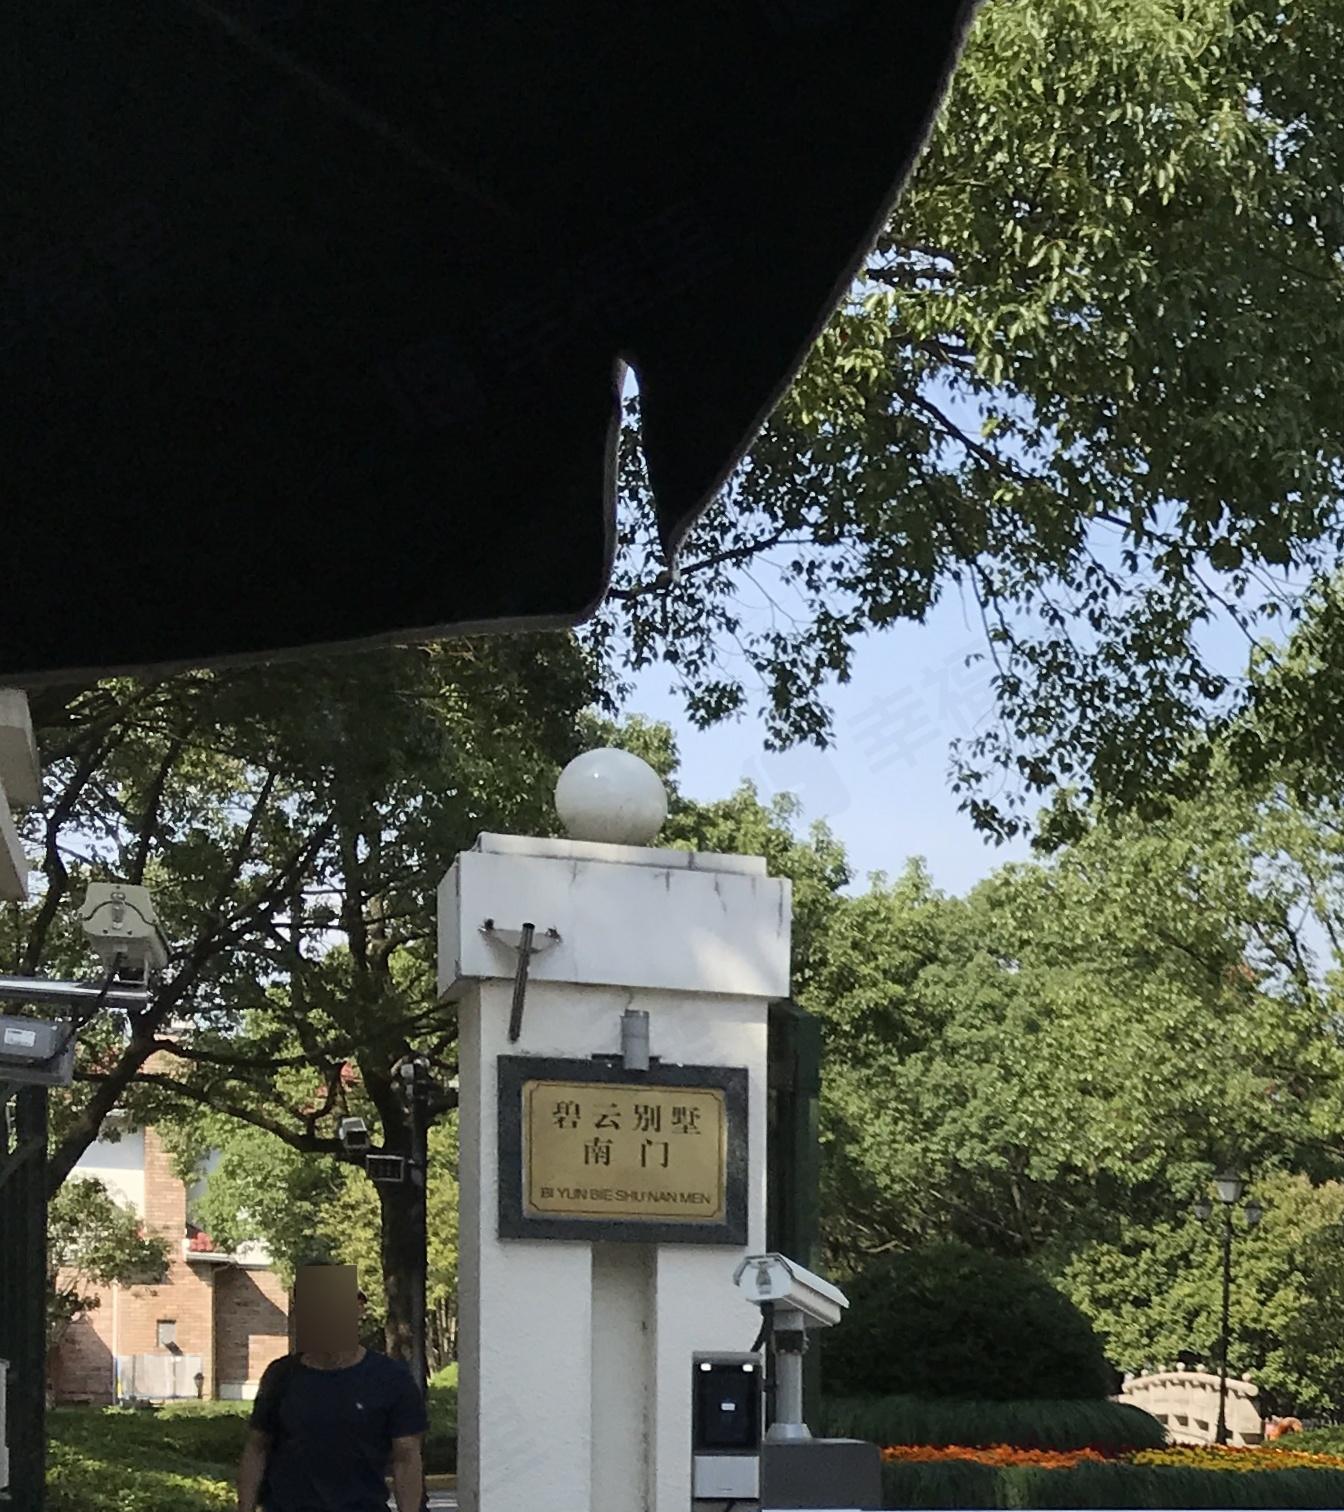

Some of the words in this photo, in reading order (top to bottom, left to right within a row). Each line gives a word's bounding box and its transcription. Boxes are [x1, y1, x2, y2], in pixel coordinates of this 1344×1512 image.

[552, 1100, 703, 1136] 碧云别墅
[583, 1137, 671, 1168] 南门
[540, 1187, 554, 1199] BI
[557, 1187, 588, 1200] YUN
[591, 1188, 613, 1201] BIE
[615, 1189, 645, 1202] SHU
[648, 1190, 677, 1203] NAN
[680, 1192, 711, 1204] MEN
